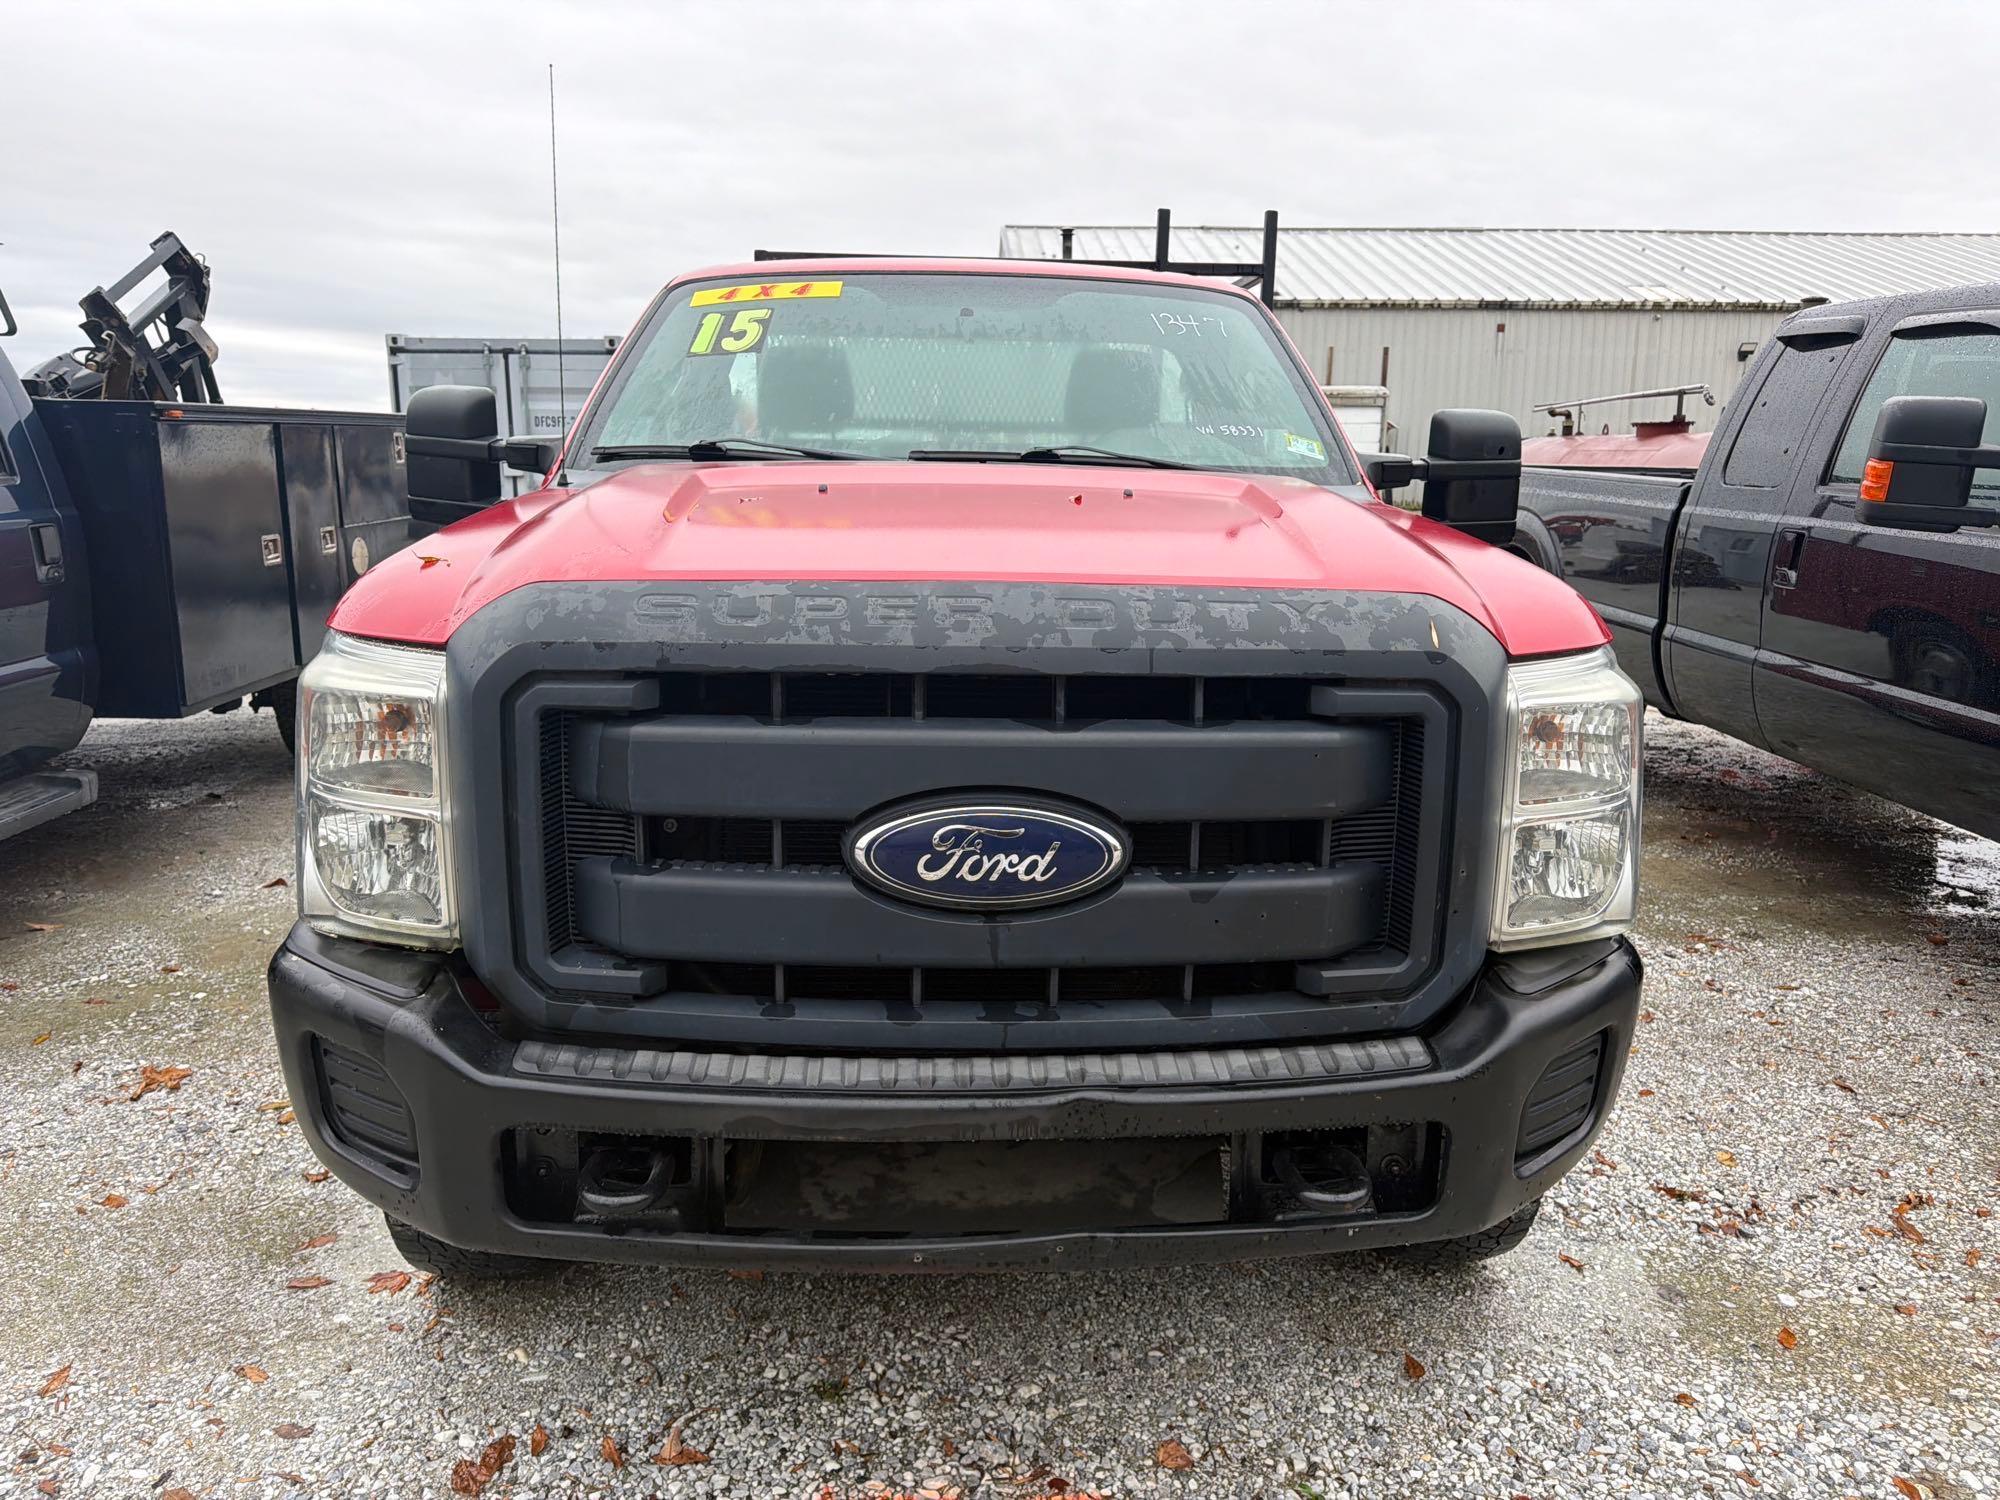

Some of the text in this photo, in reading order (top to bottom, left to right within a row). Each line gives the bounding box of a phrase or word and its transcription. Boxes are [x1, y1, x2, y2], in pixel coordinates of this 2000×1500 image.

[689, 308, 772, 354] 15
[1219, 424, 1264, 438] 58331
[633, 592, 1344, 634] SUPER DUTY
[917, 824, 1061, 882] Ford
